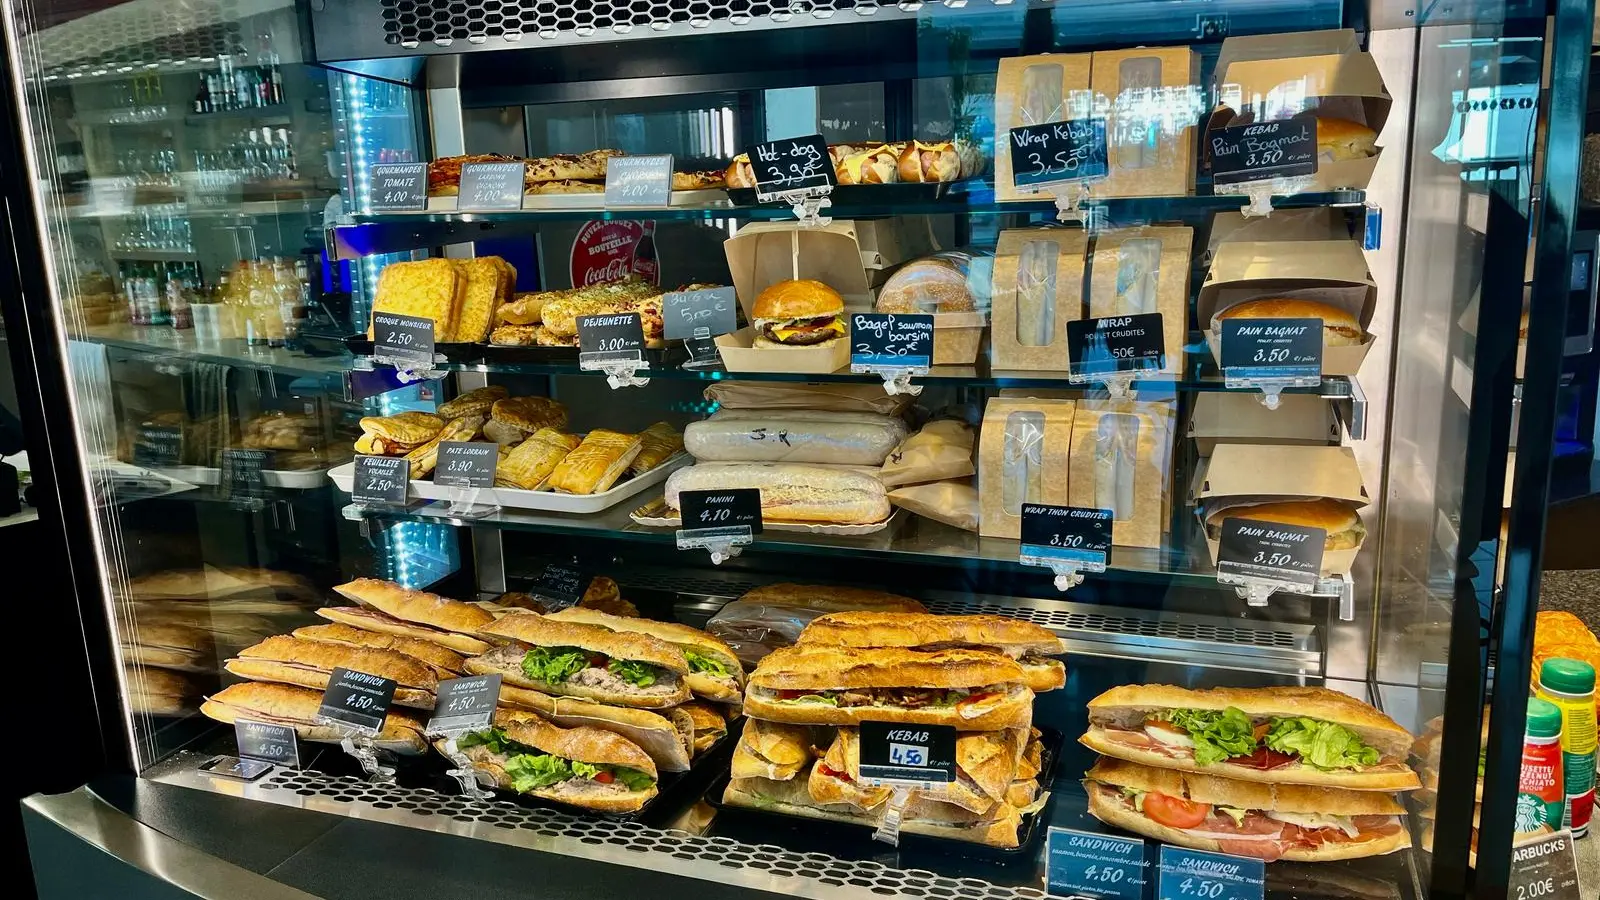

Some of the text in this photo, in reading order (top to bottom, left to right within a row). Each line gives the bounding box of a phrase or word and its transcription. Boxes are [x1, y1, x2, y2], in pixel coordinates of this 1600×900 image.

[1012, 123, 1093, 148] Wrap Kebab
[1243, 123, 1279, 136] KEBAB
[1212, 137, 1240, 156] Pain
[614, 157, 666, 168] GOURMANDES
[1245, 150, 1283, 166] 3.50
[377, 165, 422, 176] GOURMANDES
[467, 164, 518, 175] GOURMANDES
[384, 178, 415, 187] TOMATE
[384, 191, 408, 202] 4.00
[473, 190, 500, 201] 4.00
[622, 184, 648, 197] 4.00
[588, 235, 632, 255] BOUTEILLE
[375, 316, 432, 330] CROQUE MONSIEUR
[583, 315, 633, 327] DEJEUNETTE
[1096, 317, 1132, 329] WRAP
[386, 331, 412, 345] 2.50
[1237, 327, 1308, 337] PAIN BAGNAT
[599, 337, 624, 351] 3.00
[1253, 348, 1290, 362] 3.50
[368, 468, 394, 476] VOLAILLE
[448, 460, 473, 471] 3.90
[367, 478, 391, 491] 2.50
[705, 496, 735, 504] PANINI
[700, 508, 730, 522] 4.10
[1025, 506, 1046, 514] WRAP
[1048, 508, 1069, 516] THON
[1050, 534, 1083, 547] 3.50
[1237, 526, 1310, 542] PAIN BAGNAT
[1253, 551, 1292, 566] 3.50
[343, 670, 386, 686] SANDWICH
[452, 680, 487, 691] SANDWICH
[346, 693, 373, 709] 4.50
[449, 696, 475, 712] 4.50
[246, 723, 285, 736] SANDWICH
[886, 730, 930, 742] KEBAB
[259, 743, 283, 756] 4.50
[1069, 837, 1134, 854] SANDWICH
[1513, 839, 1565, 863] ARBUCKS
[1181, 858, 1240, 874] SANDWICH
[1085, 864, 1124, 883] 4.50
[1180, 878, 1223, 899] 4.50
[1517, 878, 1554, 900] 2.00€
